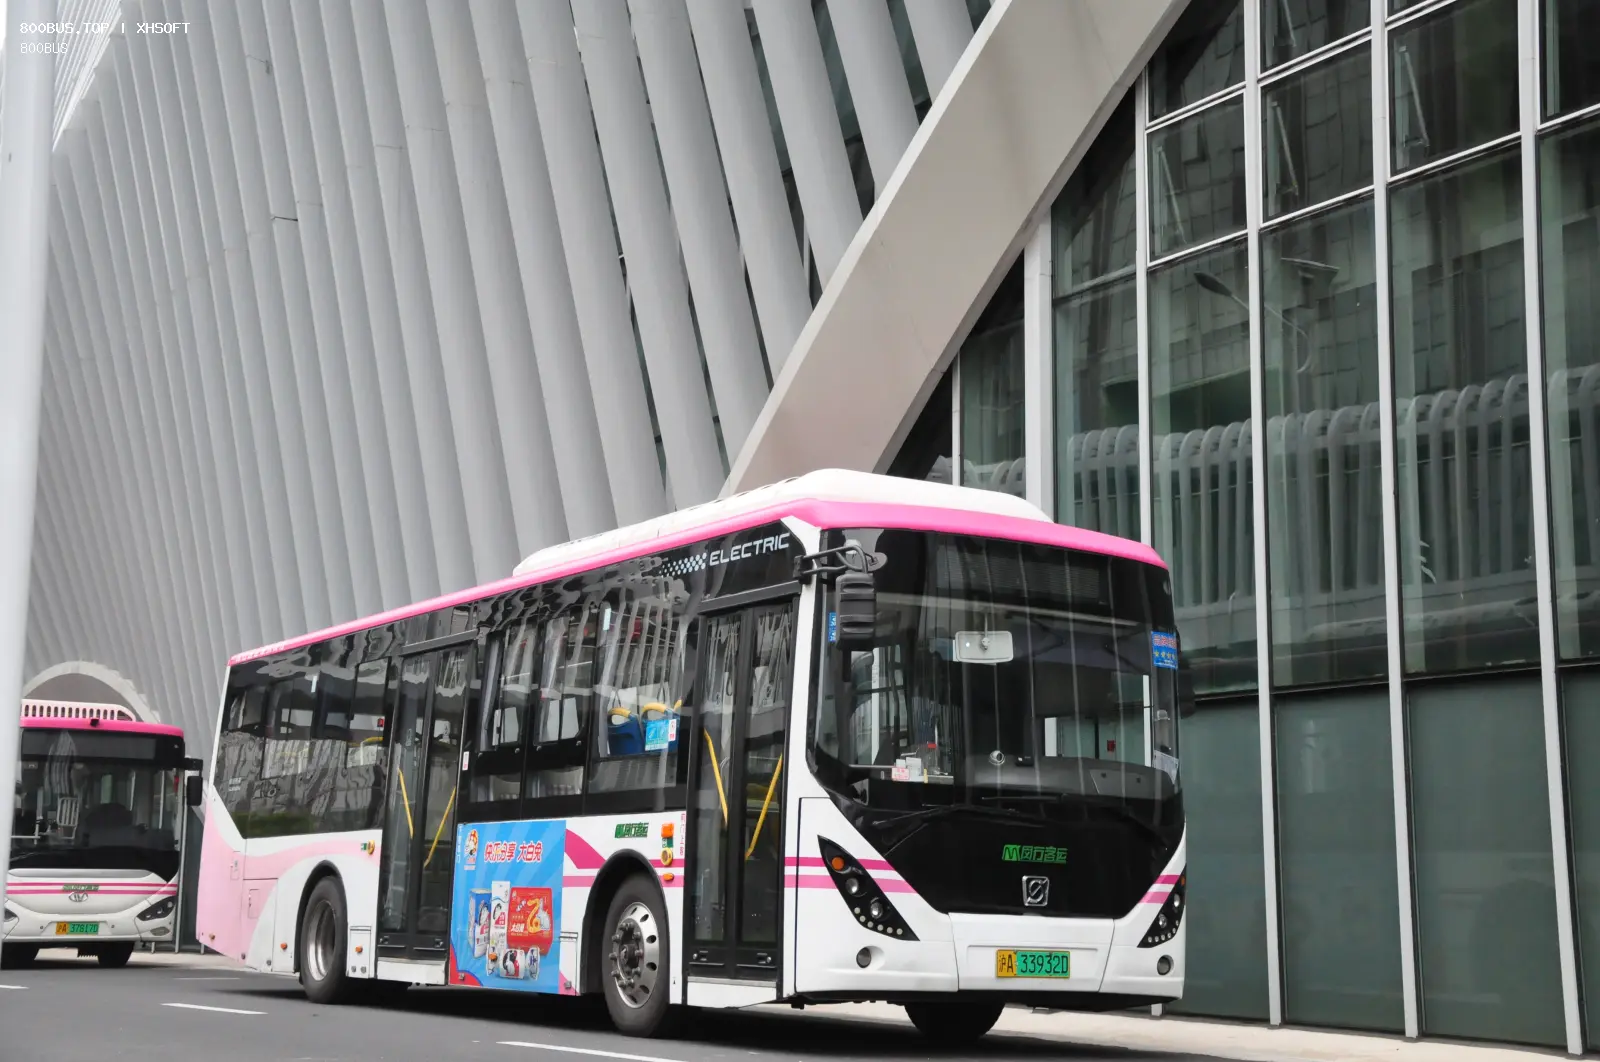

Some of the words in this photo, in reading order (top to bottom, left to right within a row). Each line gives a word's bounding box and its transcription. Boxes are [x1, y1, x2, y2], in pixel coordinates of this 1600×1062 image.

[709, 532, 790, 566] ELECTRIC
[485, 841, 517, 862] 快乐分享
[518, 841, 543, 861] 大白兔
[1020, 954, 1069, 974] 33932D
